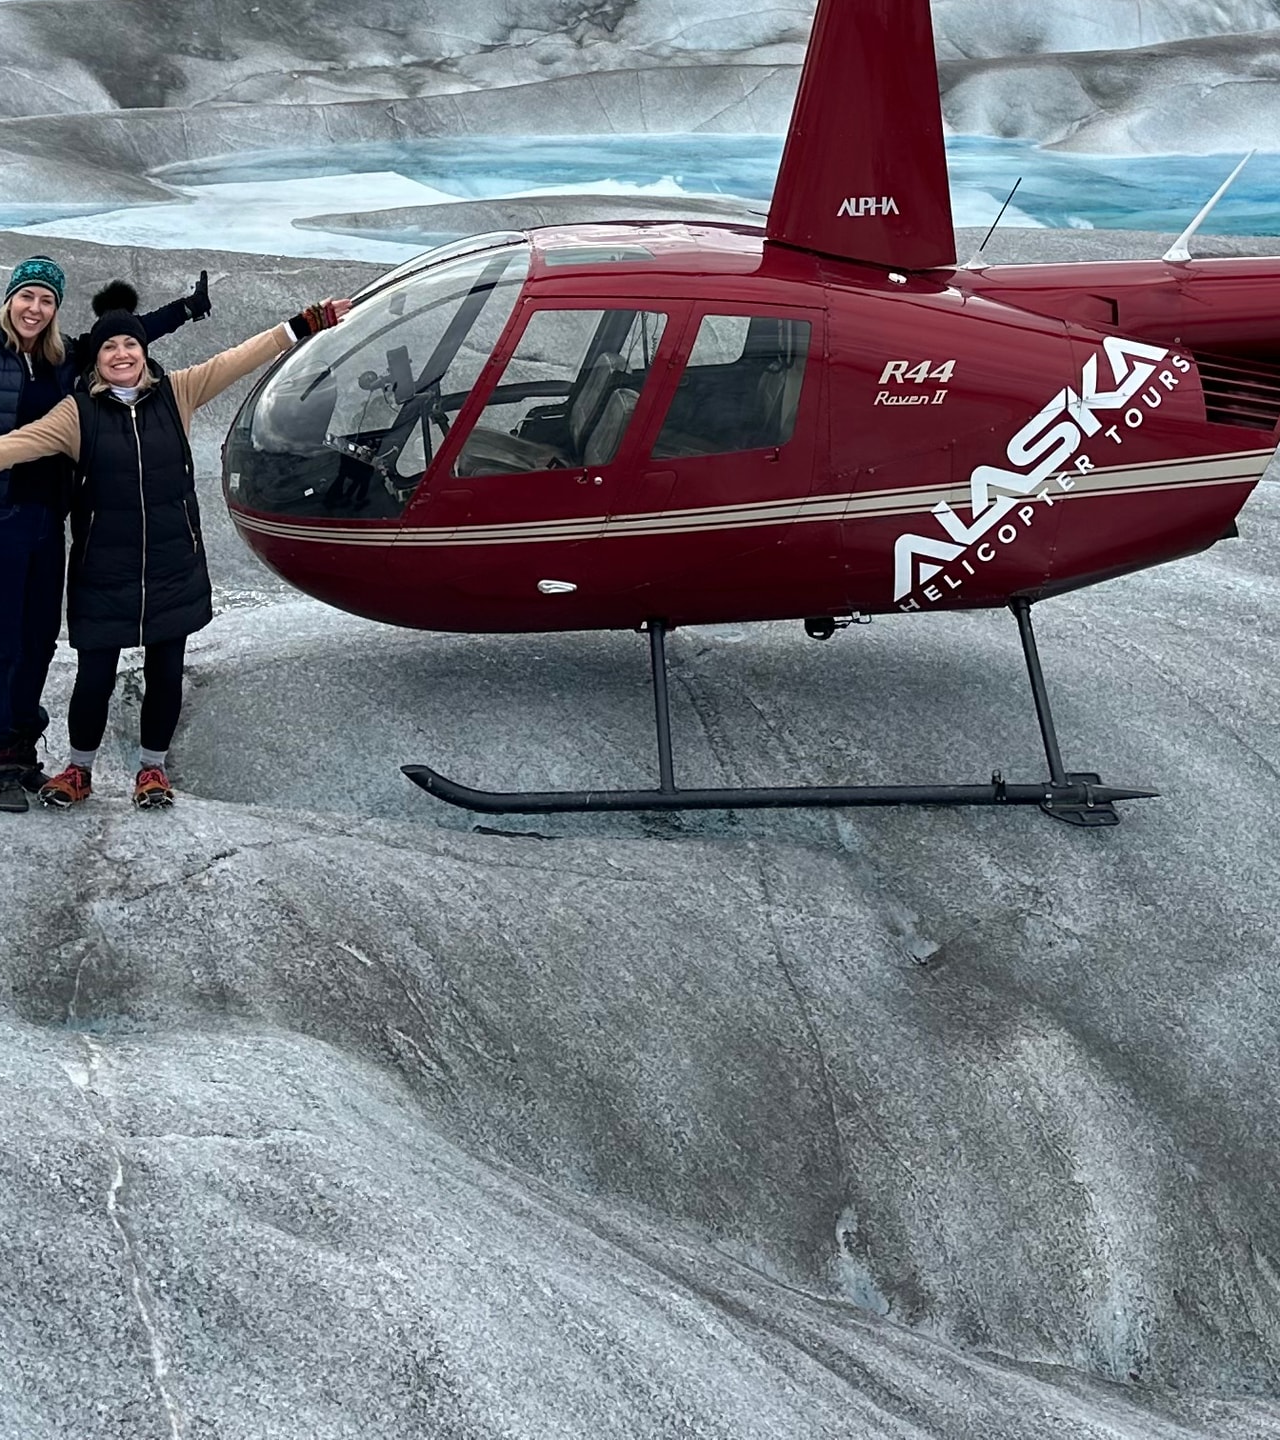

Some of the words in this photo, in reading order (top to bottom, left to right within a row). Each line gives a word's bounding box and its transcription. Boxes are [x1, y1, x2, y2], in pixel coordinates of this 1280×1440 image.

[836, 196, 900, 217] ALPHA
[877, 359, 957, 385] R44
[873, 390, 930, 406] Raven
[930, 389, 949, 405] II
[893, 335, 1170, 603] ALASKA
[898, 453, 1096, 612] HELICOPTER
[1104, 354, 1191, 445] TOURS
